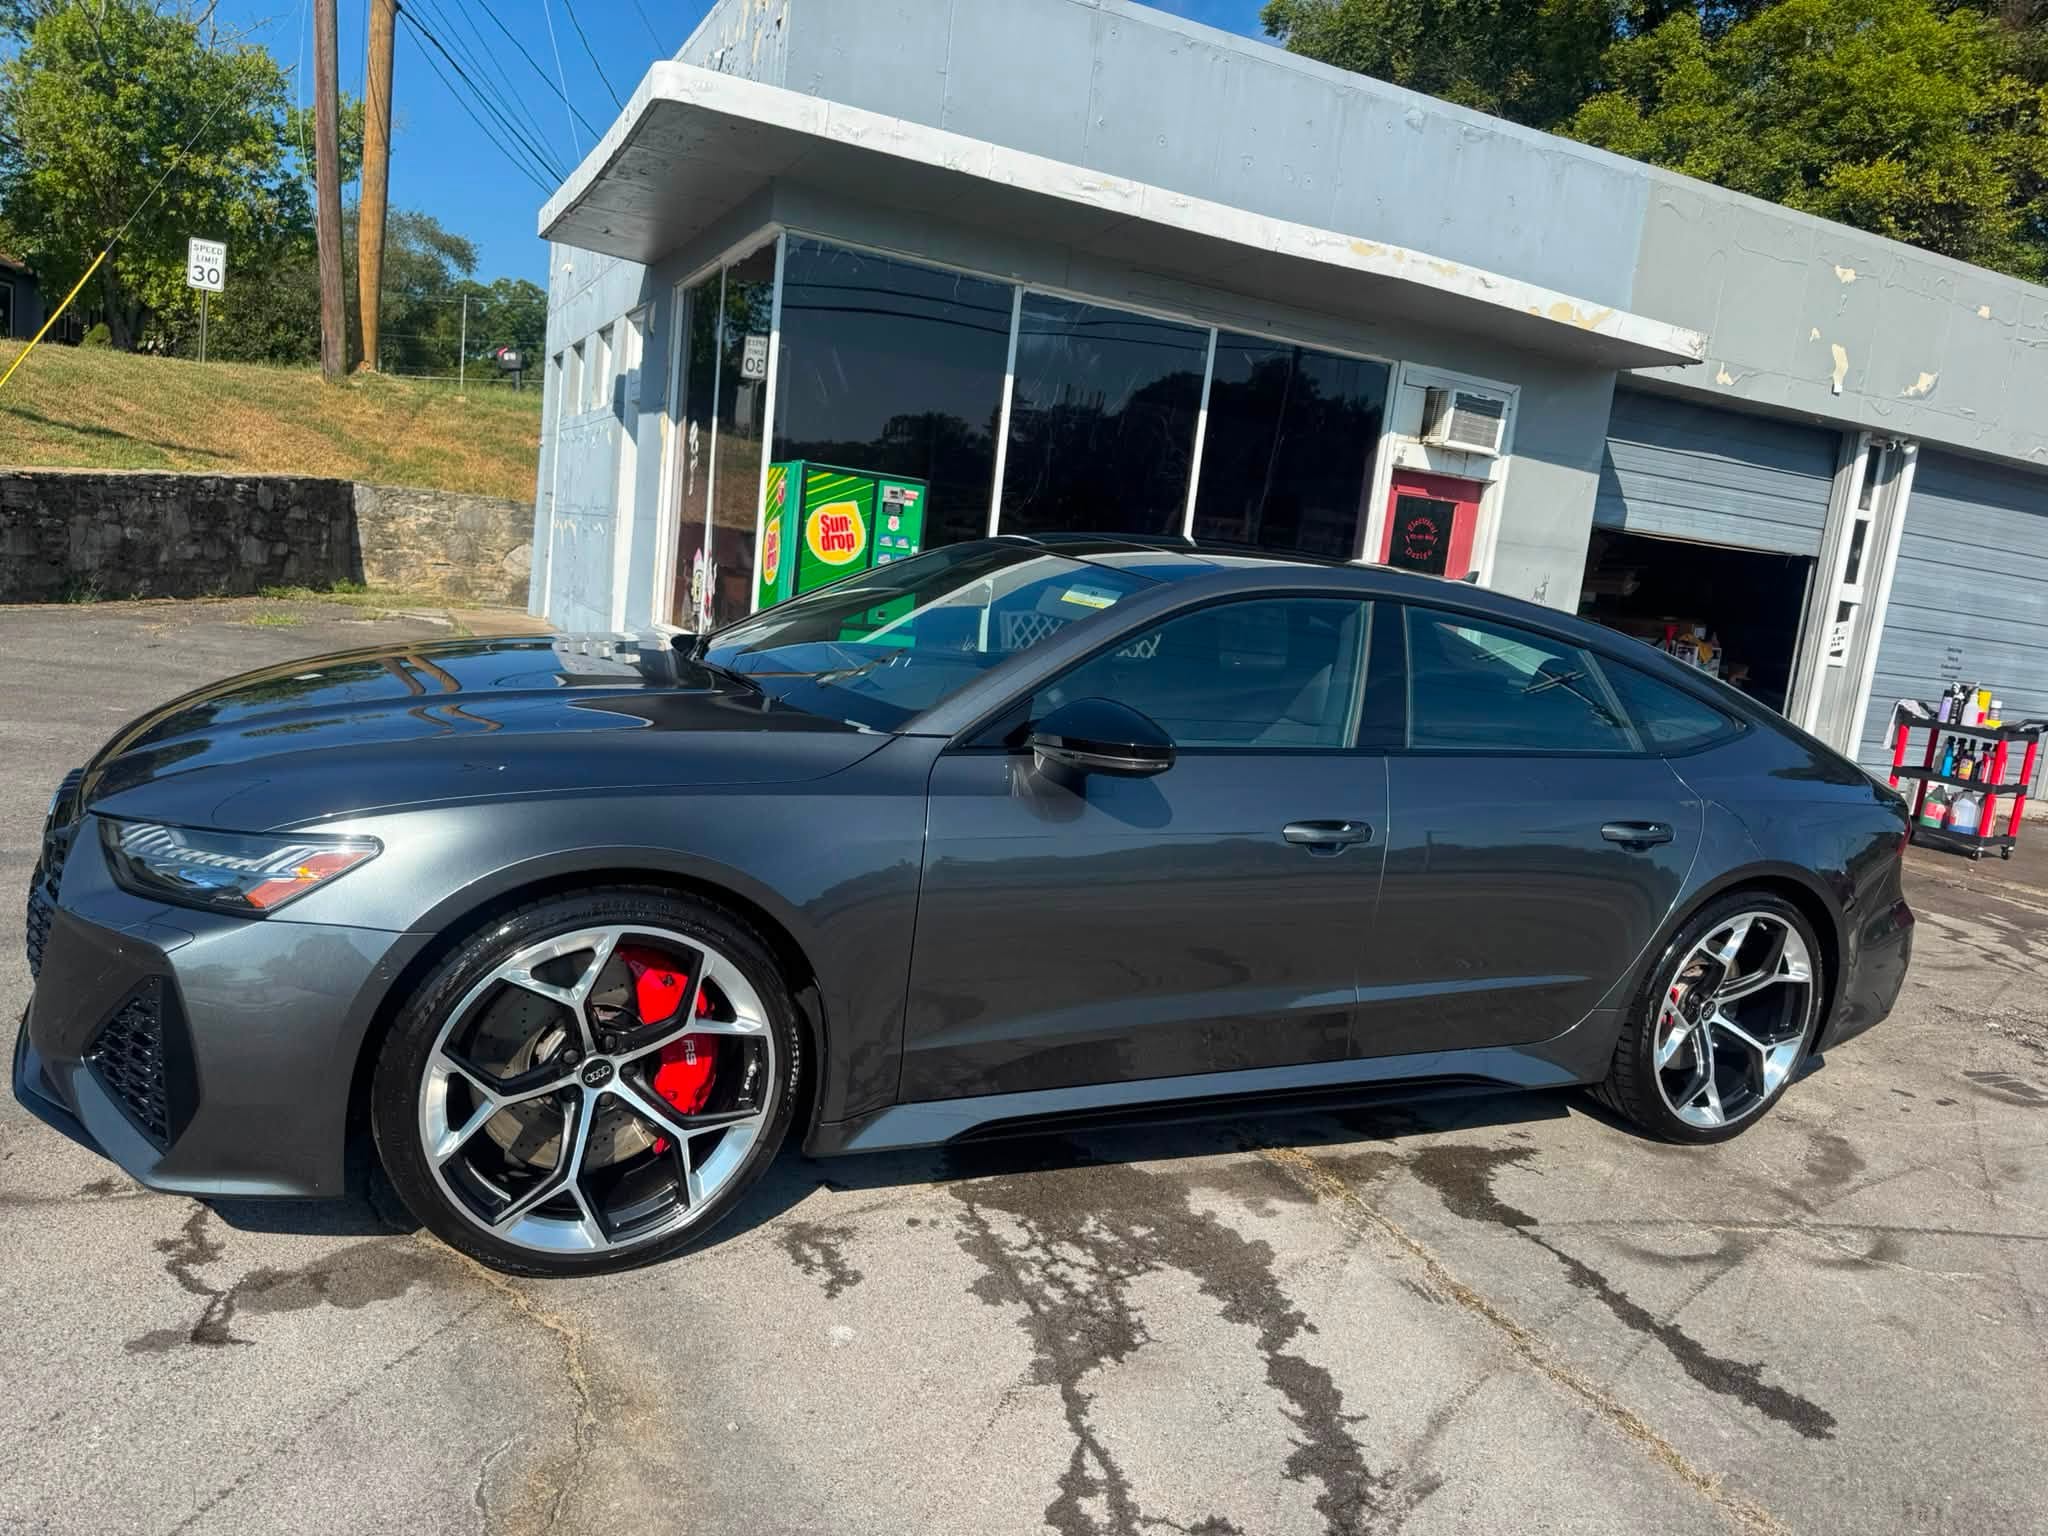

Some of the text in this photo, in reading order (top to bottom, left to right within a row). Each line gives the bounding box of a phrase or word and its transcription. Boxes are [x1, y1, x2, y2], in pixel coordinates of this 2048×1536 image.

[193, 243, 223, 255] SPEED
[196, 254, 218, 265] LIMIT
[192, 265, 220, 284] 30
[821, 530, 856, 552] drop
[683, 1039, 698, 1066] RS
